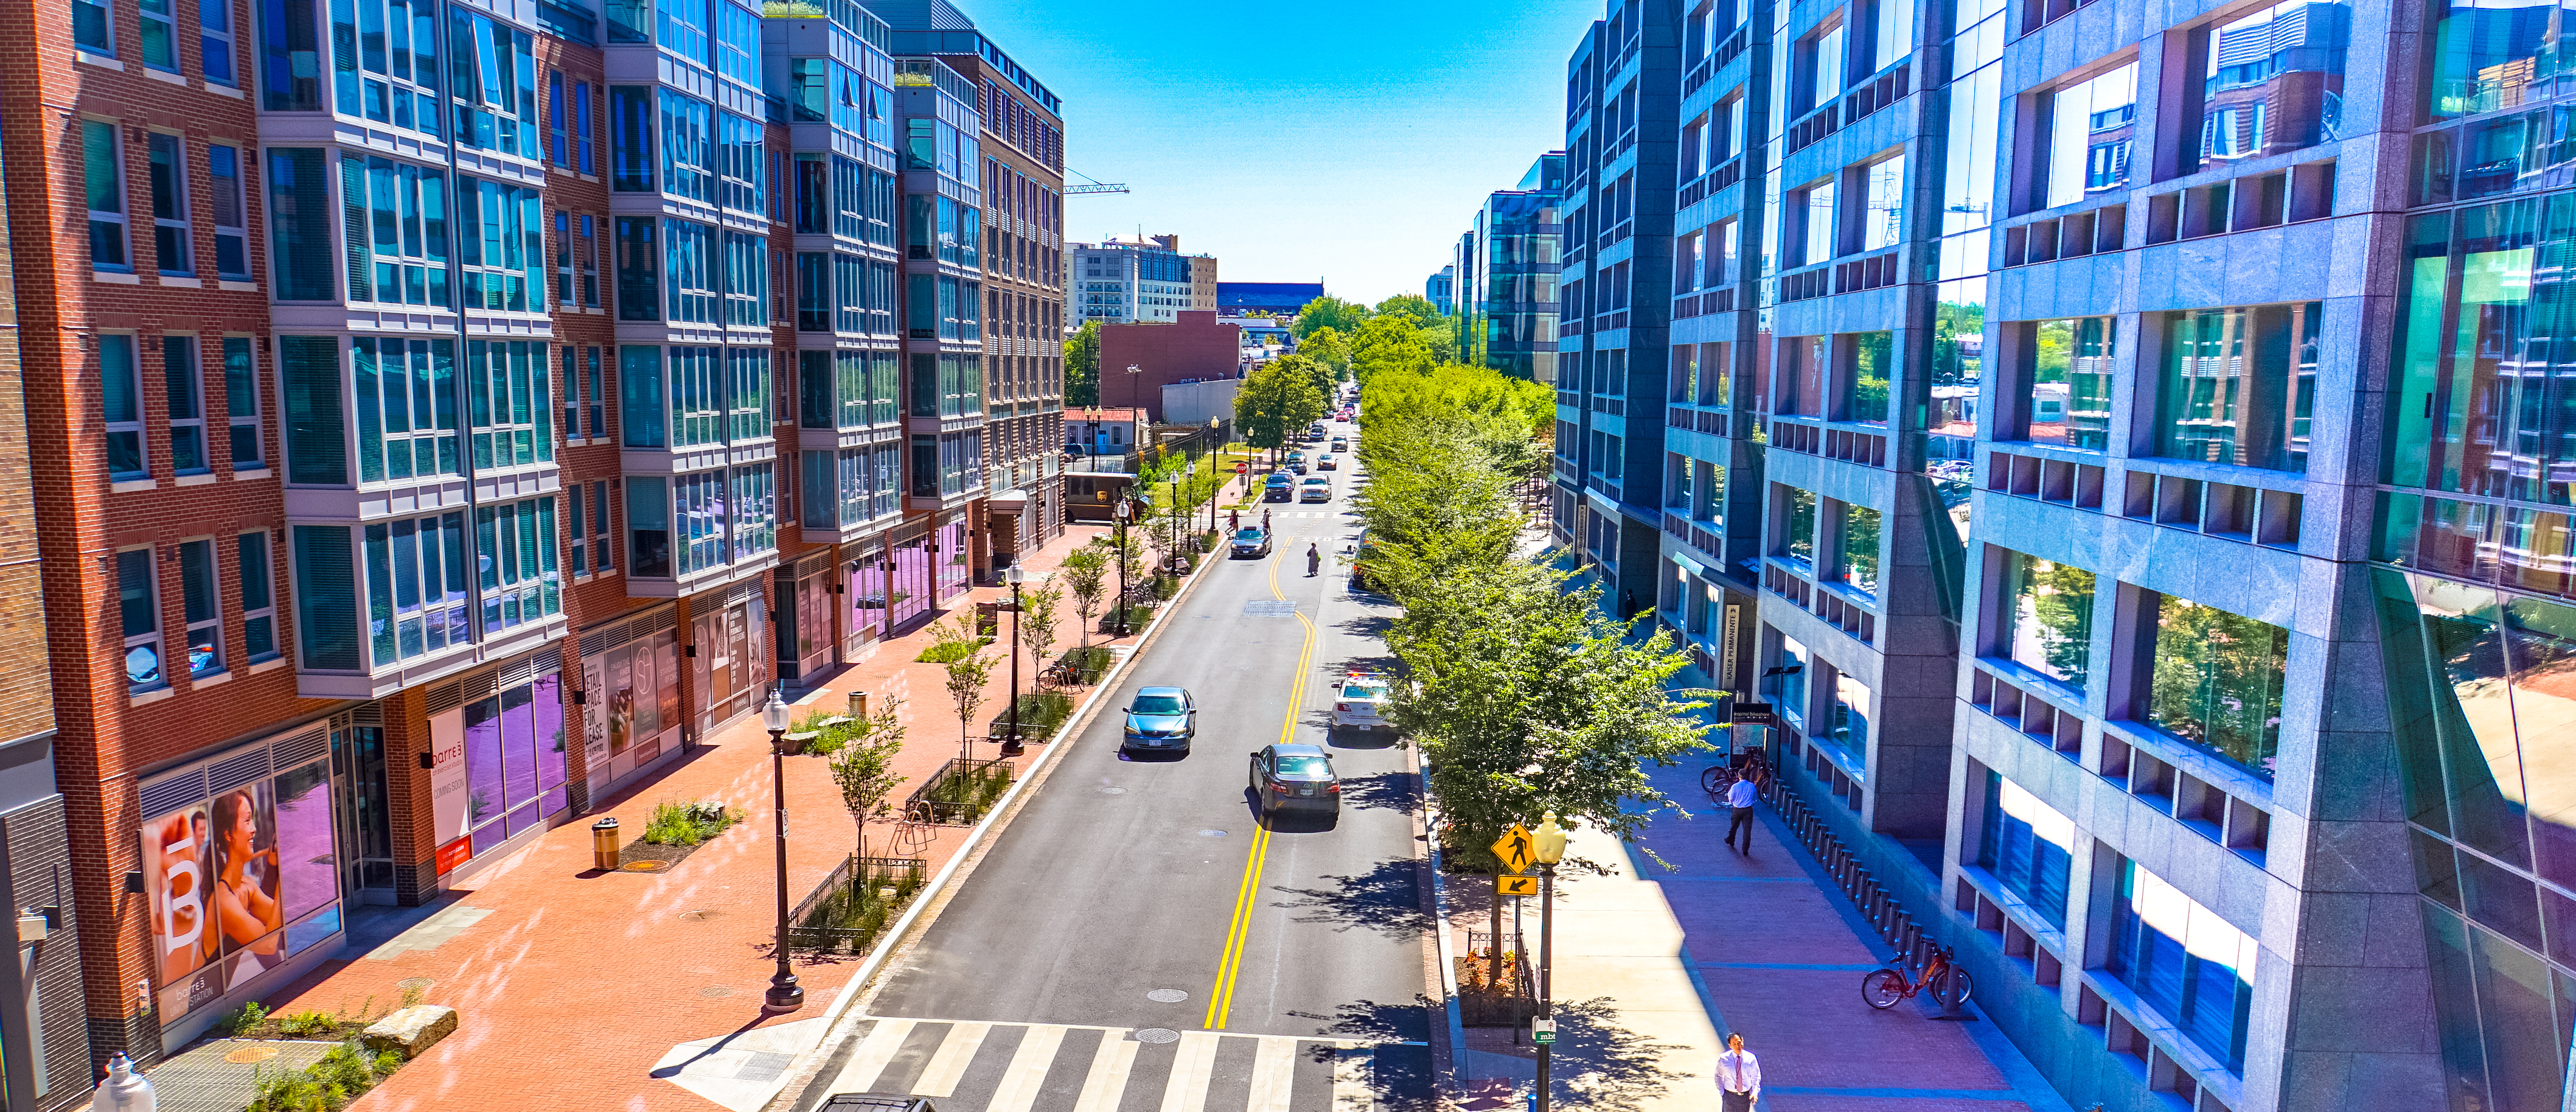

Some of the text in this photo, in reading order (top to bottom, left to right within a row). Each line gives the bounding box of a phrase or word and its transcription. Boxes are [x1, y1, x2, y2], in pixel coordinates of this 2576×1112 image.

[585, 671, 602, 692] ETAIL
[584, 708, 596, 728] FOR
[585, 722, 603, 746] LEASE
[437, 764, 451, 774] exercise
[452, 759, 462, 768] studio
[434, 777, 464, 799] COMING SOON
[189, 986, 214, 1006] STATION
